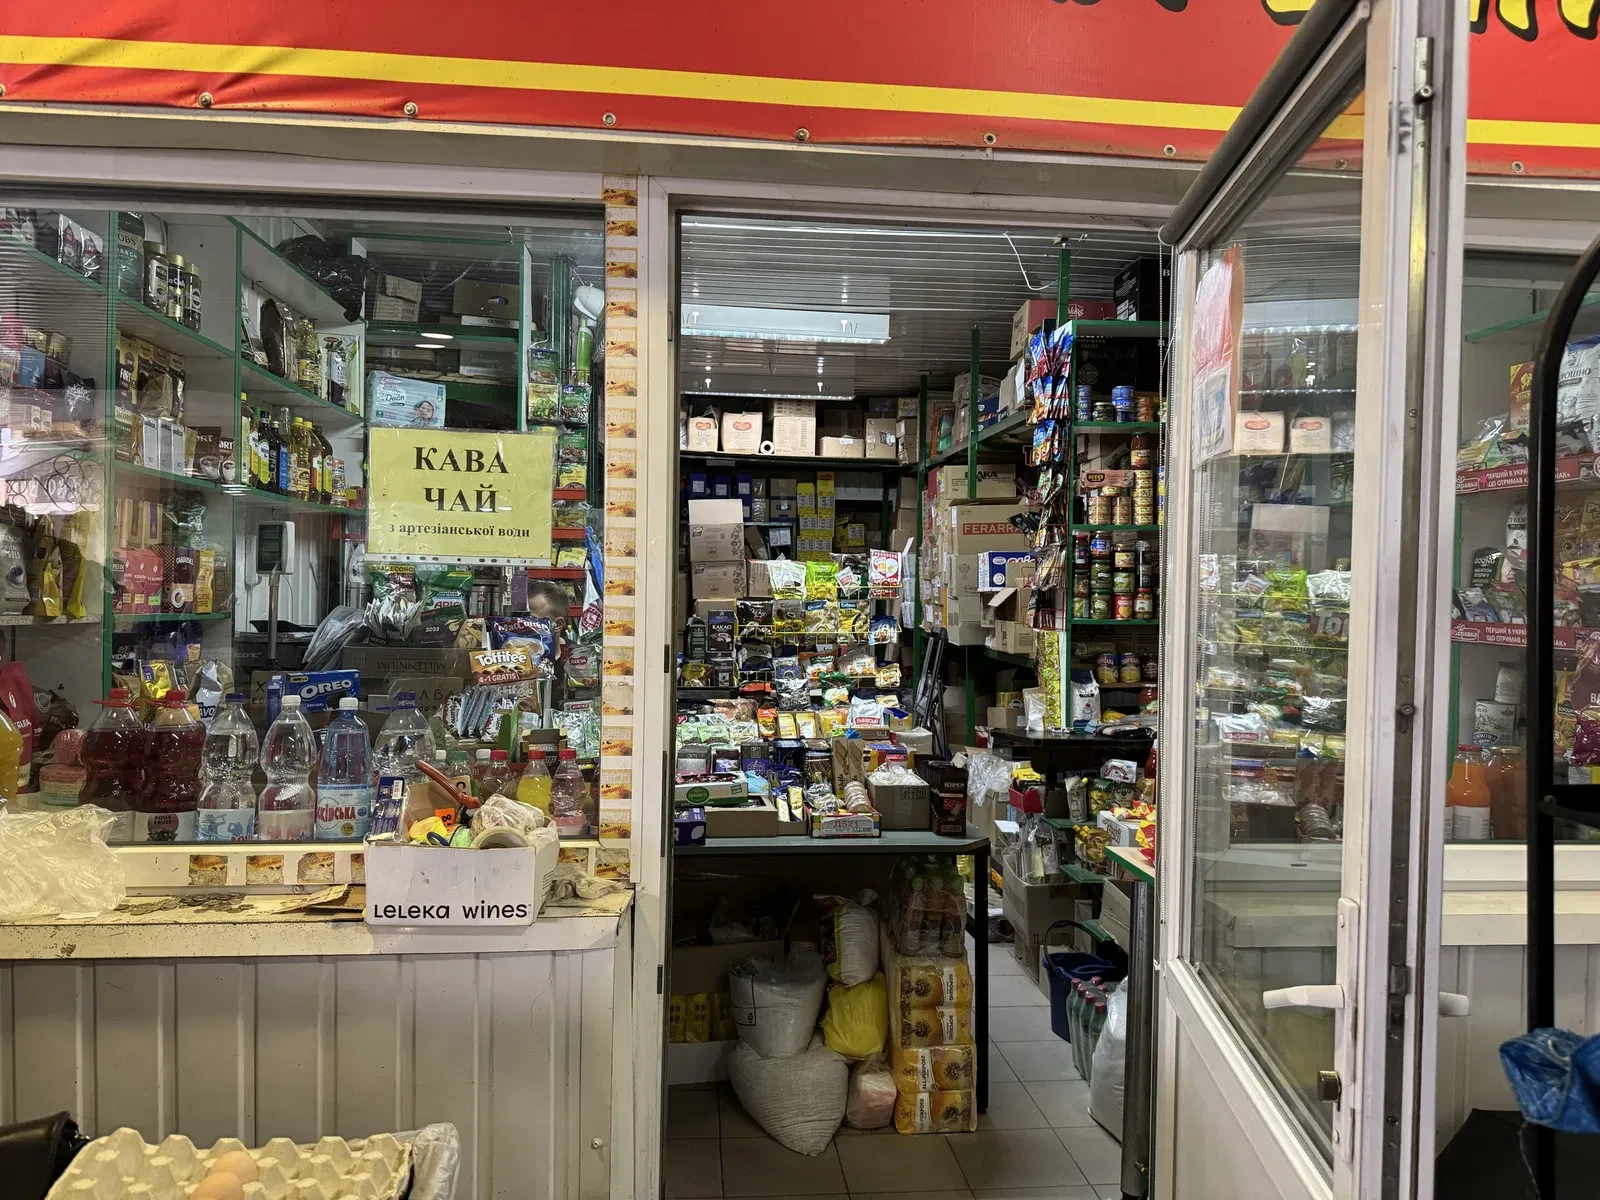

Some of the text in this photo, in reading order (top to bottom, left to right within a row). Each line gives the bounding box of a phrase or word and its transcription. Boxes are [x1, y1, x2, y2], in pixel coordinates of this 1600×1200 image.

[413, 446, 509, 474] КАВА
[423, 484, 499, 513] ЧАЙ
[389, 523, 530, 538] з артезіанської води
[377, 661, 447, 671] MILLENNIUM
[475, 650, 527, 667] Toffifee
[492, 672, 518, 682] GRATIS
[300, 679, 353, 699] OREO
[450, 704, 458, 725] bueno
[462, 900, 529, 919] wines
